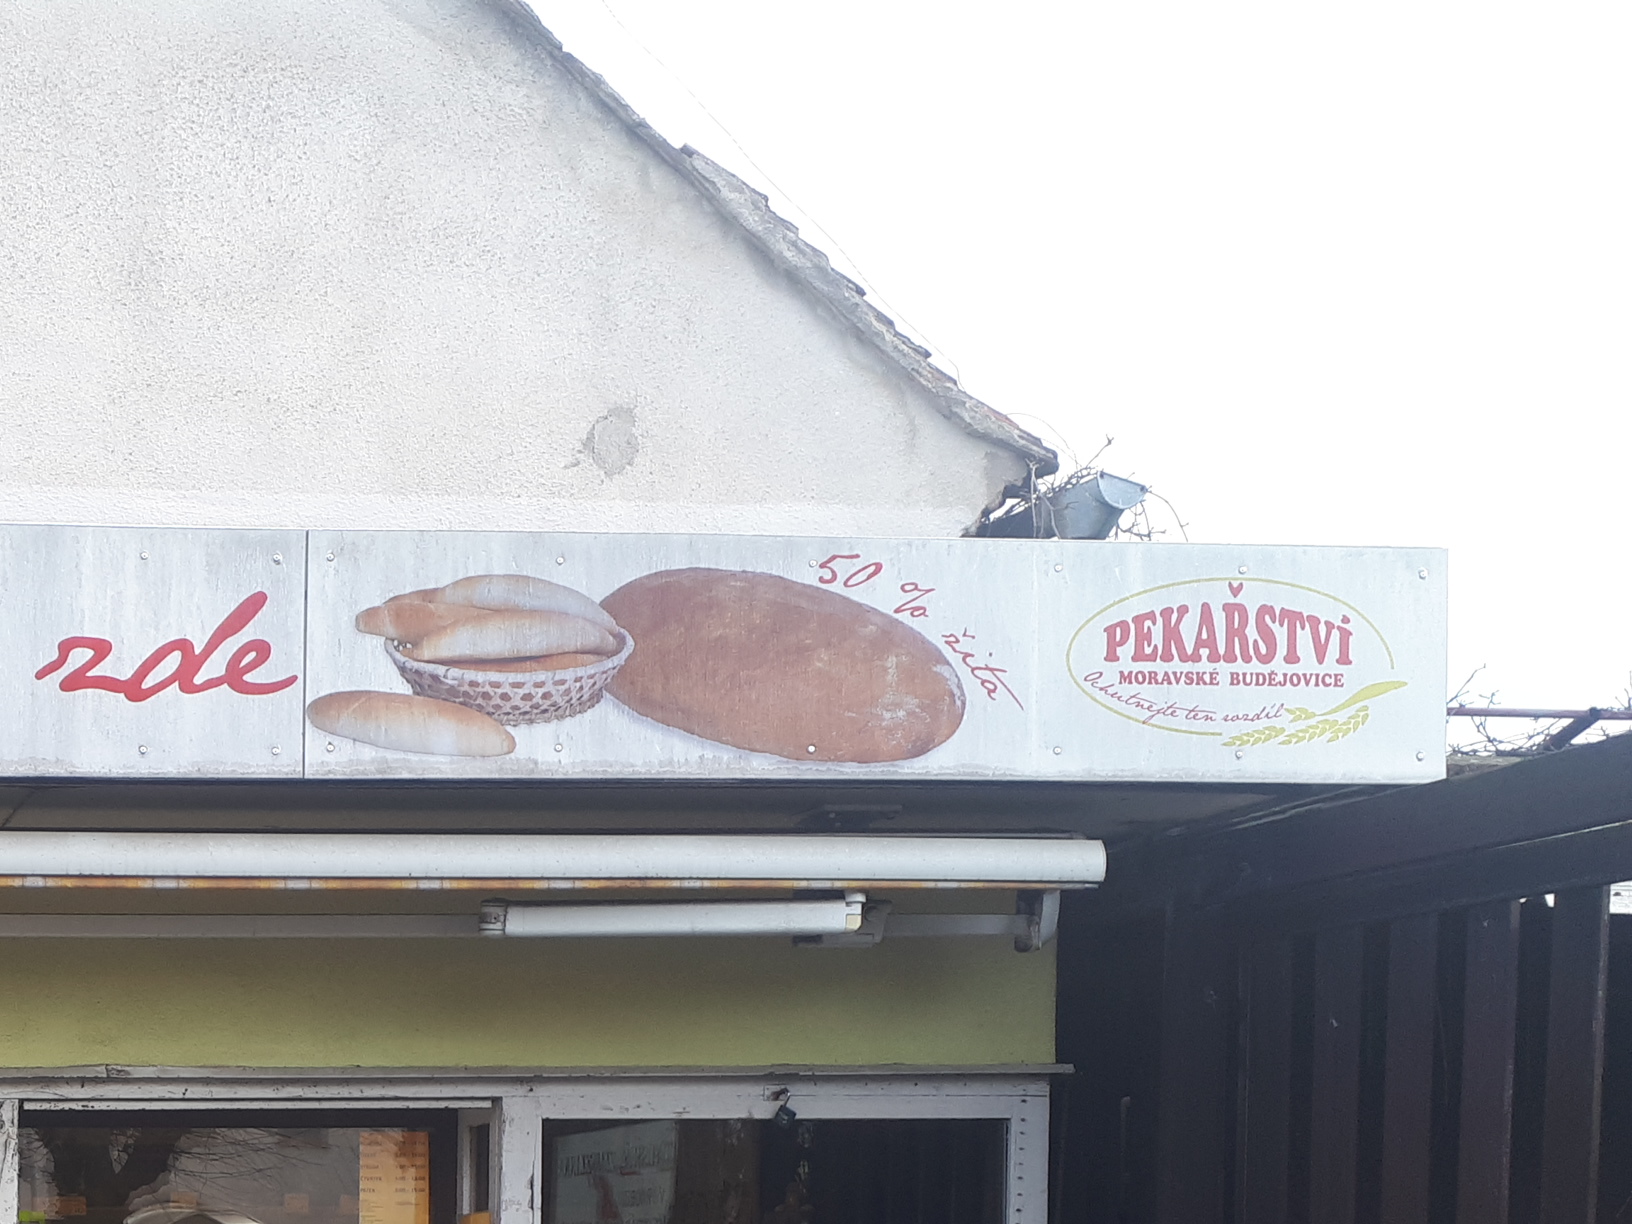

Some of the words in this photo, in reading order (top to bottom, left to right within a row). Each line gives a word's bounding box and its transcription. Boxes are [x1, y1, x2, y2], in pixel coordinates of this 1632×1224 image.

[35, 591, 299, 703] zde
[818, 553, 884, 588] 50
[893, 581, 936, 618] %
[940, 627, 1024, 711] žita
[1083, 671, 1179, 725] Ochutnejte
[1185, 705, 1217, 723] ten
[1222, 703, 1285, 723] rozdíl
[1118, 668, 1220, 687] MORAVSKÉ
[1229, 669, 1345, 689] BUDĚJOVICE
